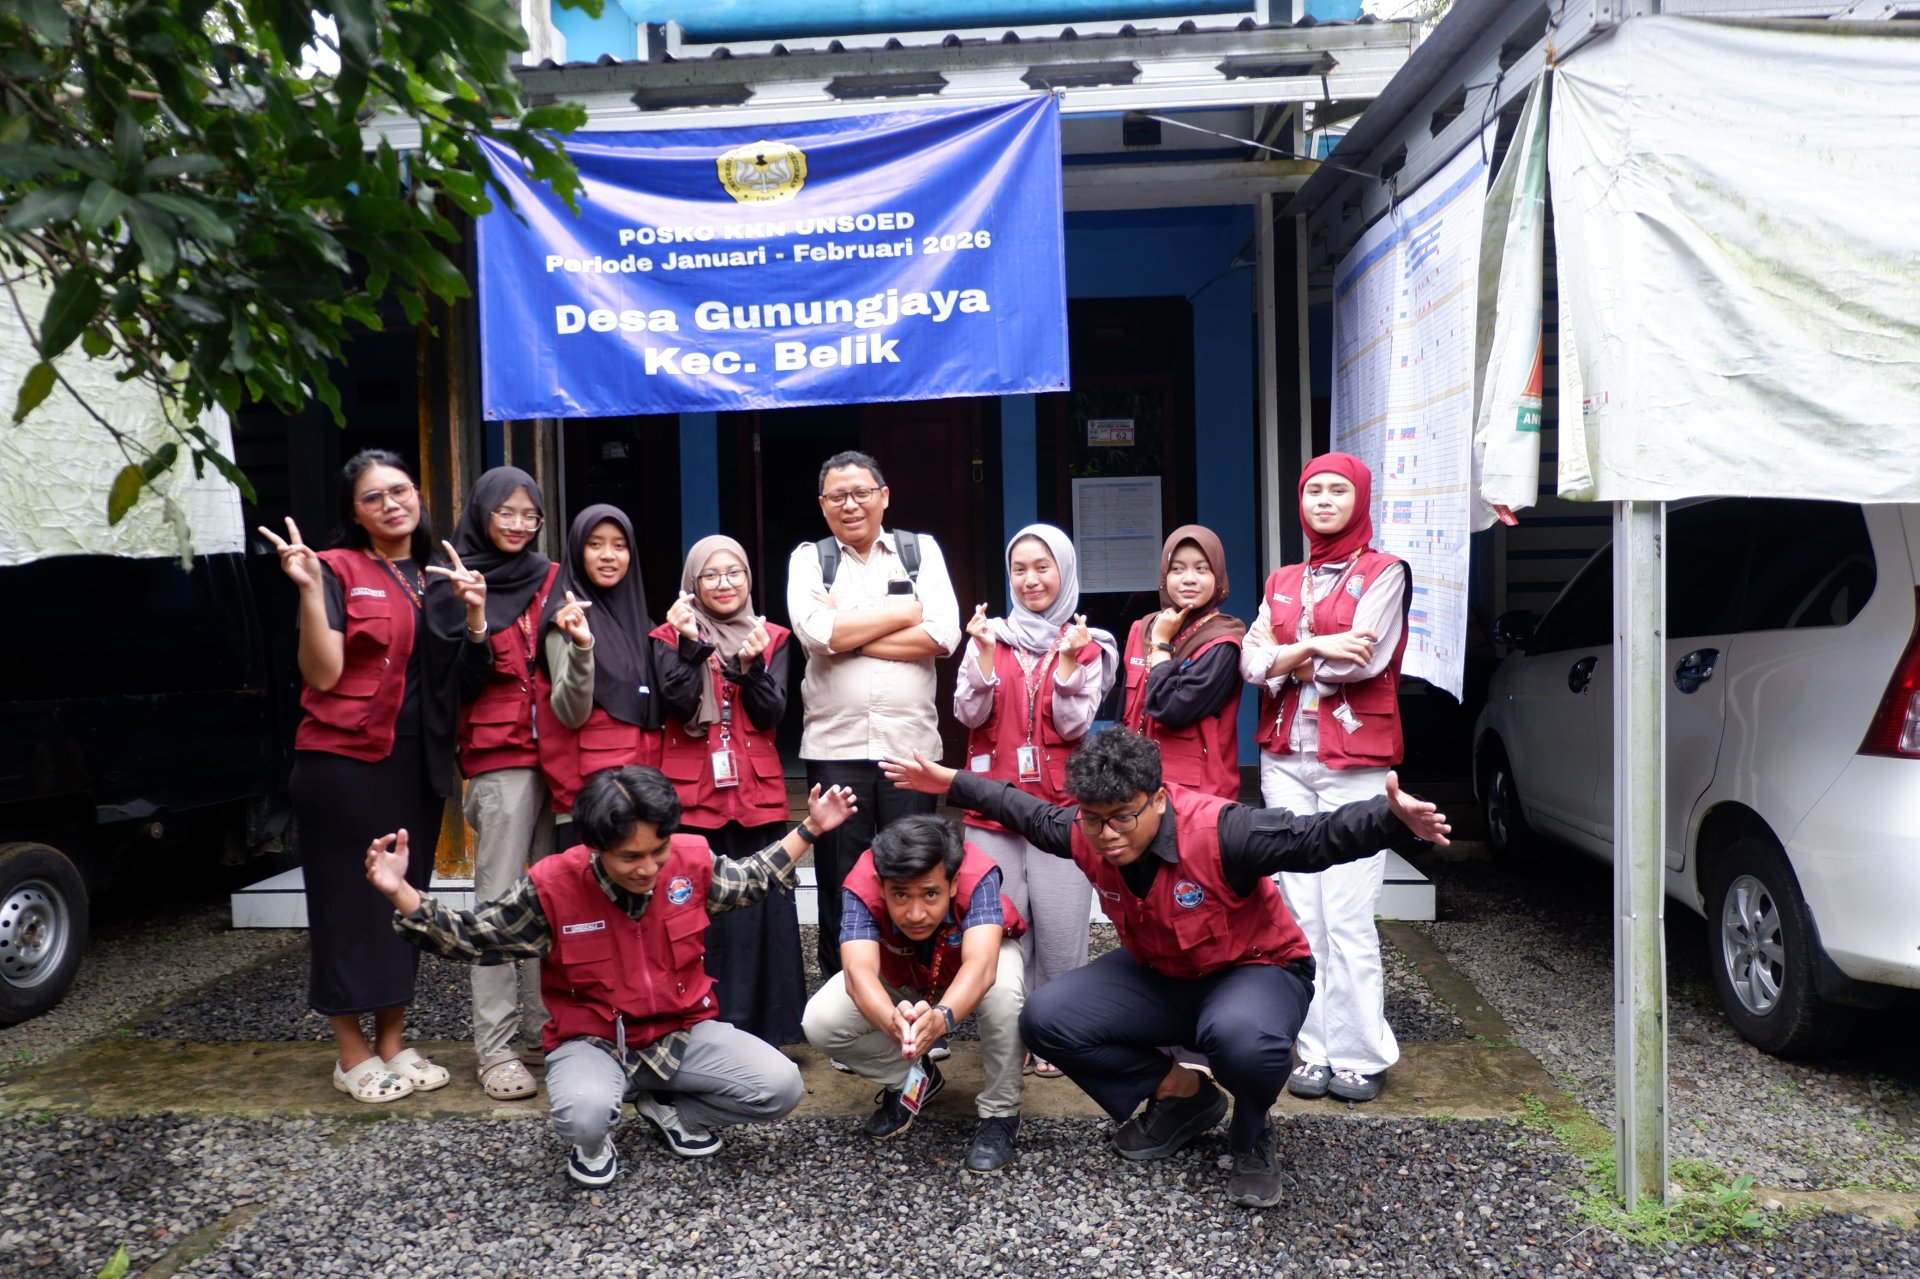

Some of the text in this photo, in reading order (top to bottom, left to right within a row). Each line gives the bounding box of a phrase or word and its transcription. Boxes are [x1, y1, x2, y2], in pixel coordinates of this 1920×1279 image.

[618, 212, 915, 246] POSKO KKN UNSOED
[546, 254, 653, 273] Periode
[661, 246, 767, 271] Januari
[793, 238, 913, 262] Februari
[922, 230, 992, 254] 2026
[555, 288, 991, 335] Desa Gunungjaya
[644, 333, 901, 376] Kec. Belik
[1523, 412, 1541, 425] AN
